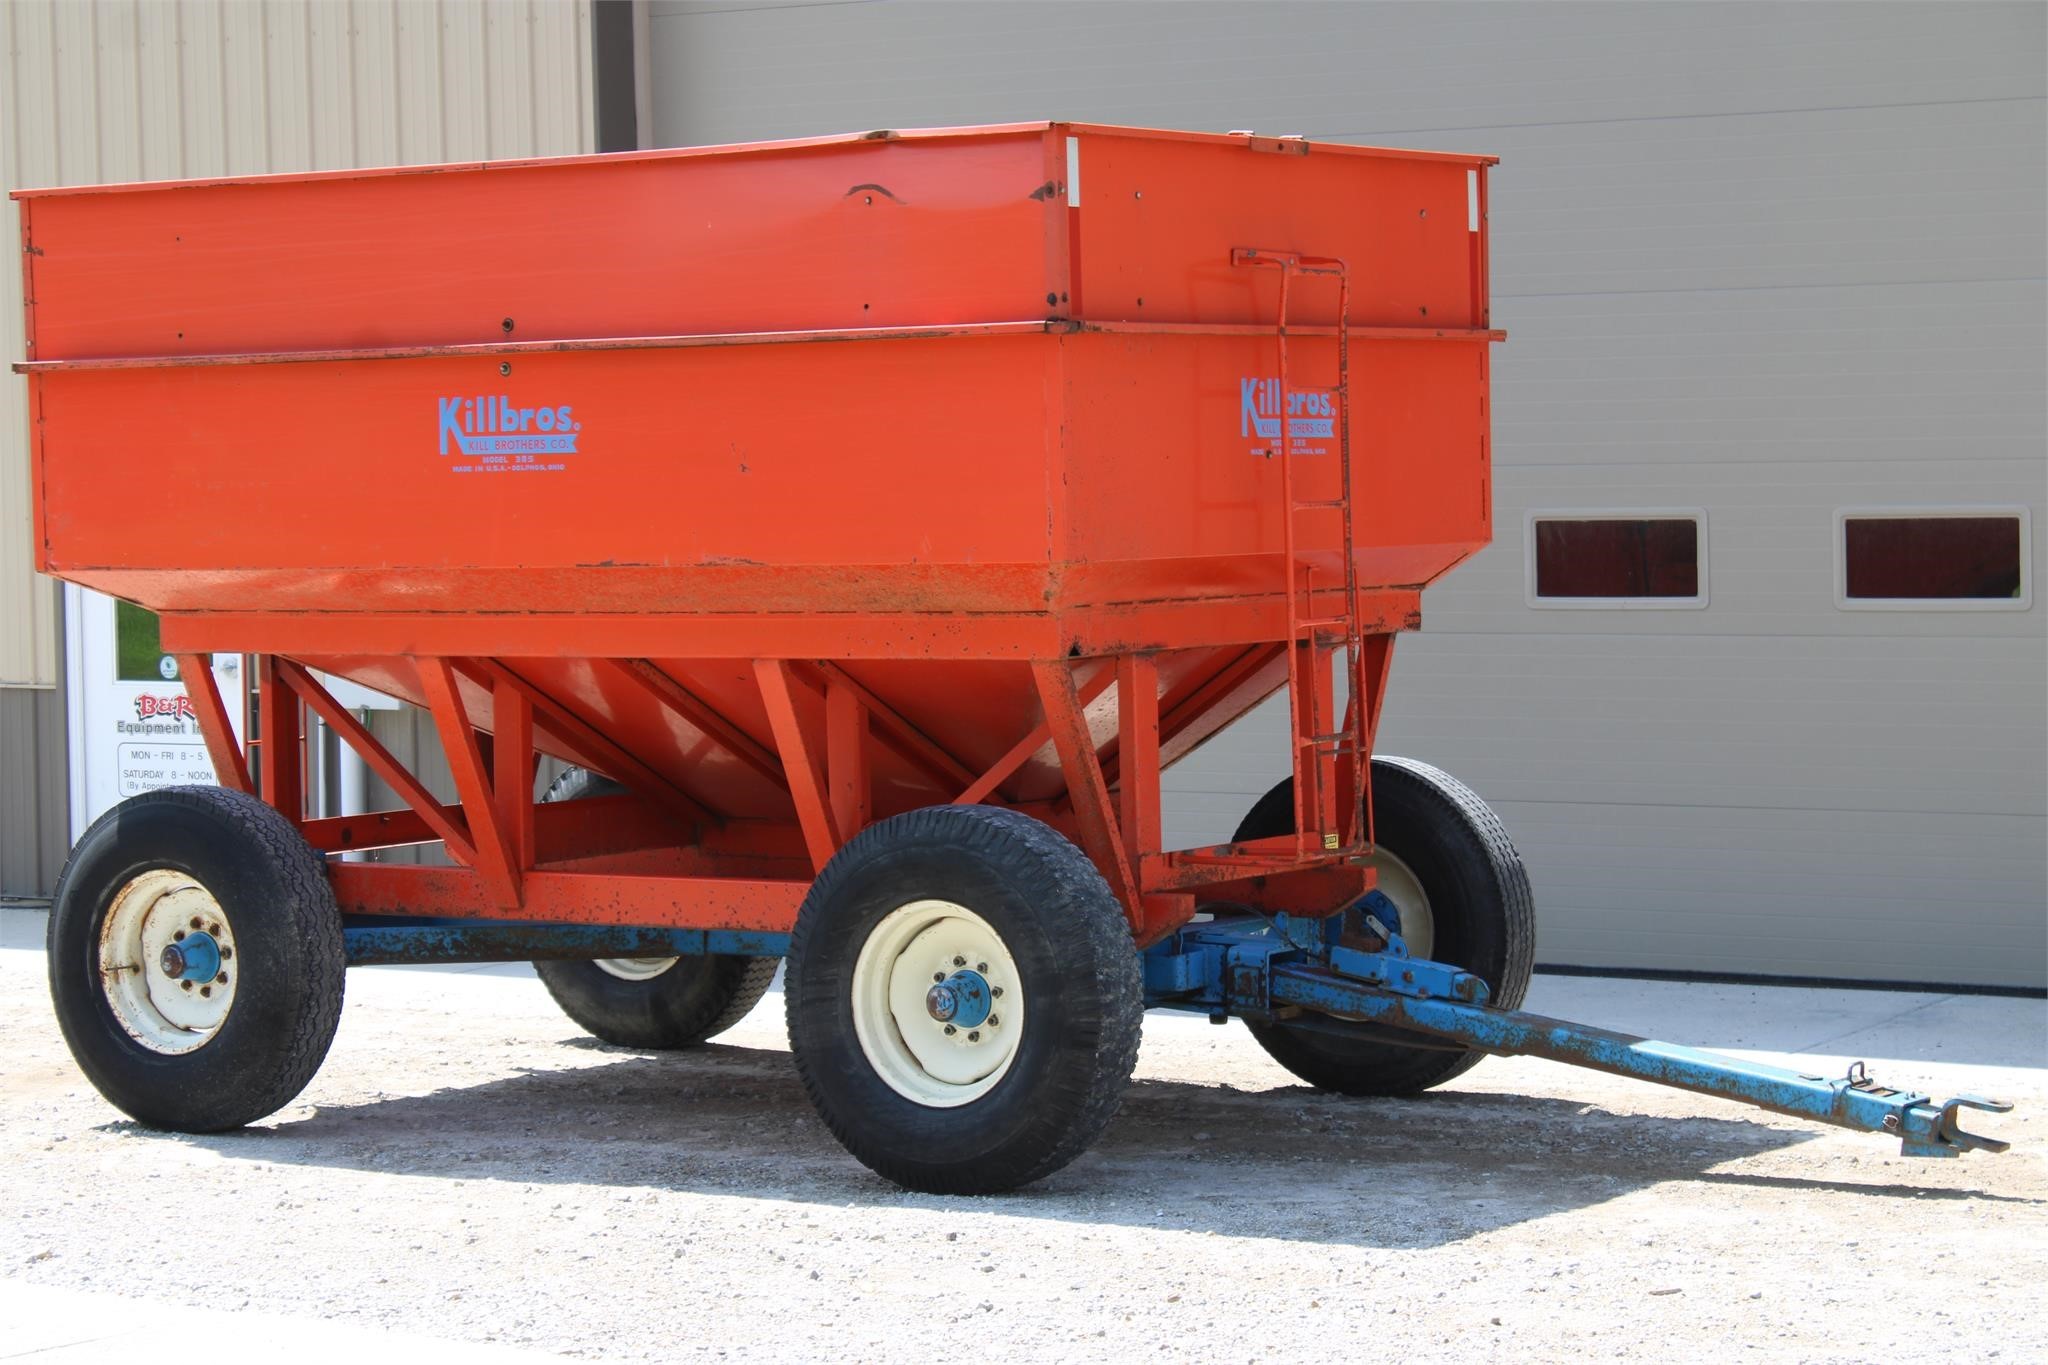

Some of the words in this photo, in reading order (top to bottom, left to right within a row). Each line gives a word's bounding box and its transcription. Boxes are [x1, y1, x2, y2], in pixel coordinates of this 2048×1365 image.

[439, 395, 582, 455] Killbros.
[469, 440, 489, 450] KILL
[495, 440, 546, 450] BROTHERS
[551, 439, 569, 449] CO.
[117, 720, 186, 735] Equipment
[131, 751, 150, 760] MON
[161, 752, 174, 760] FRI
[123, 769, 164, 779] SATURDAY
[171, 771, 176, 779] 8
[188, 772, 212, 780] NOON
